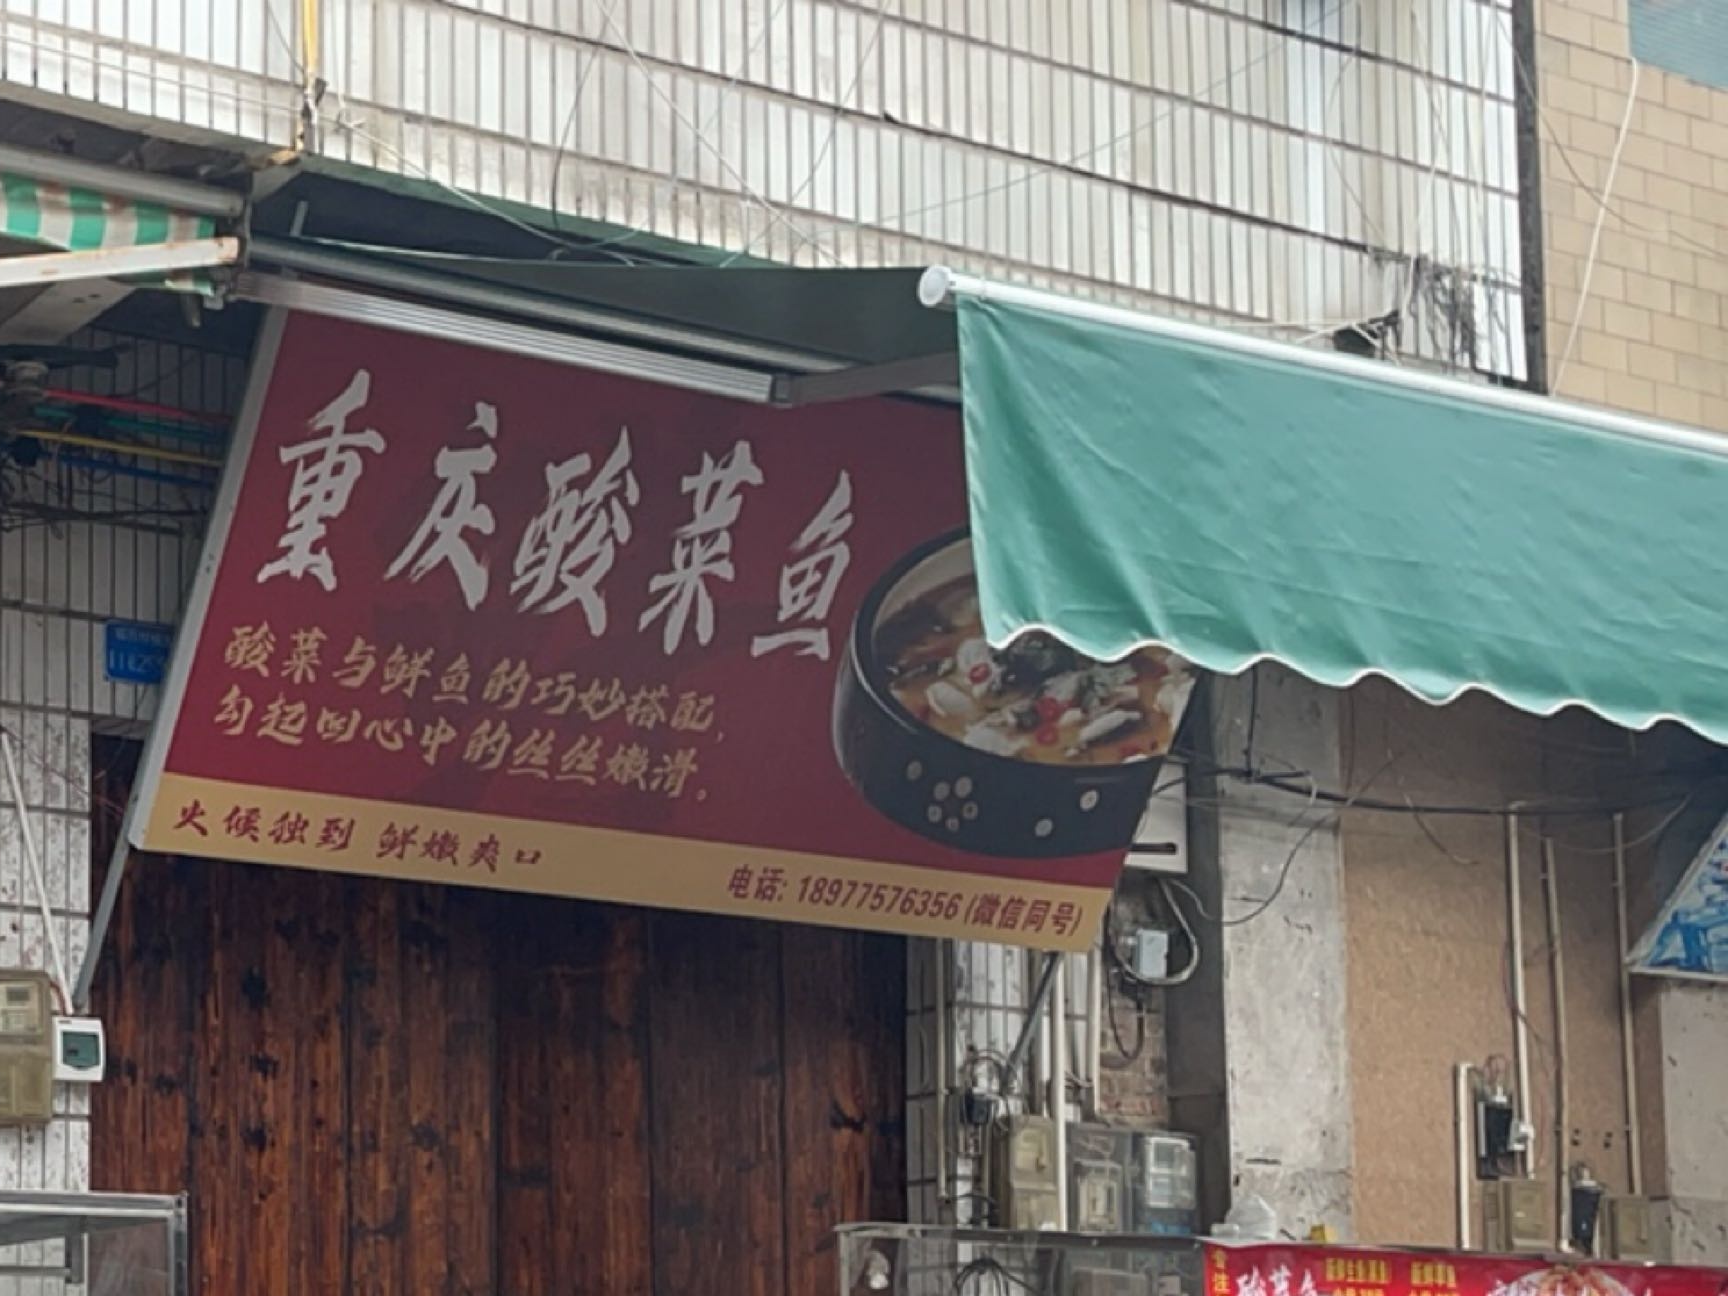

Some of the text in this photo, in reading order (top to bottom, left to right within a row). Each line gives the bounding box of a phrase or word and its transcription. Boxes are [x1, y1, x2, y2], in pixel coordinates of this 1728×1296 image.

[256, 368, 854, 661] 重庆酸菜鱼
